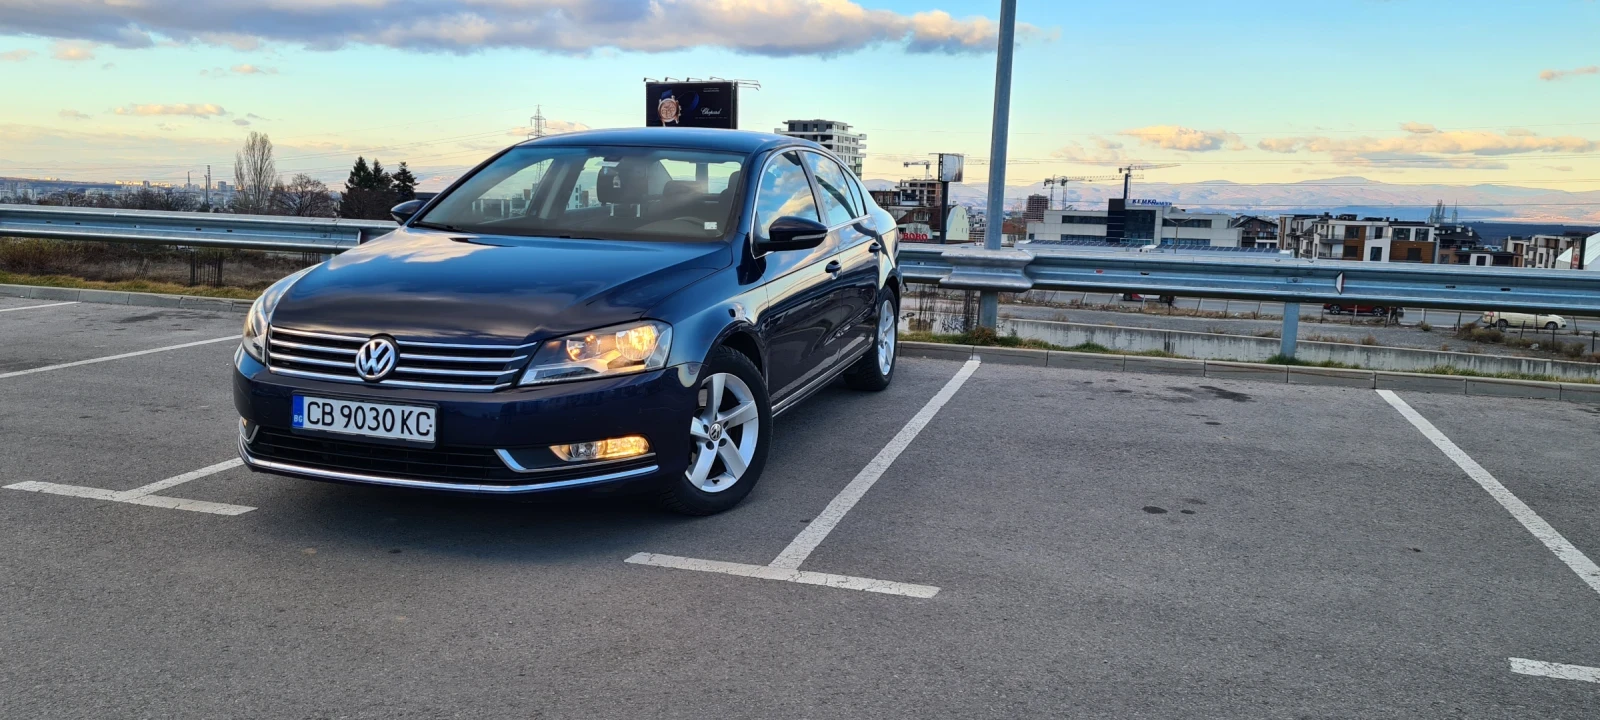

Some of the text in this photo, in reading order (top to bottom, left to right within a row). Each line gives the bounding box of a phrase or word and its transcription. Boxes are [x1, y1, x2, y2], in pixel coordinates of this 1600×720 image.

[293, 414, 303, 423] BG
[307, 401, 432, 437] CB 9030 KC
